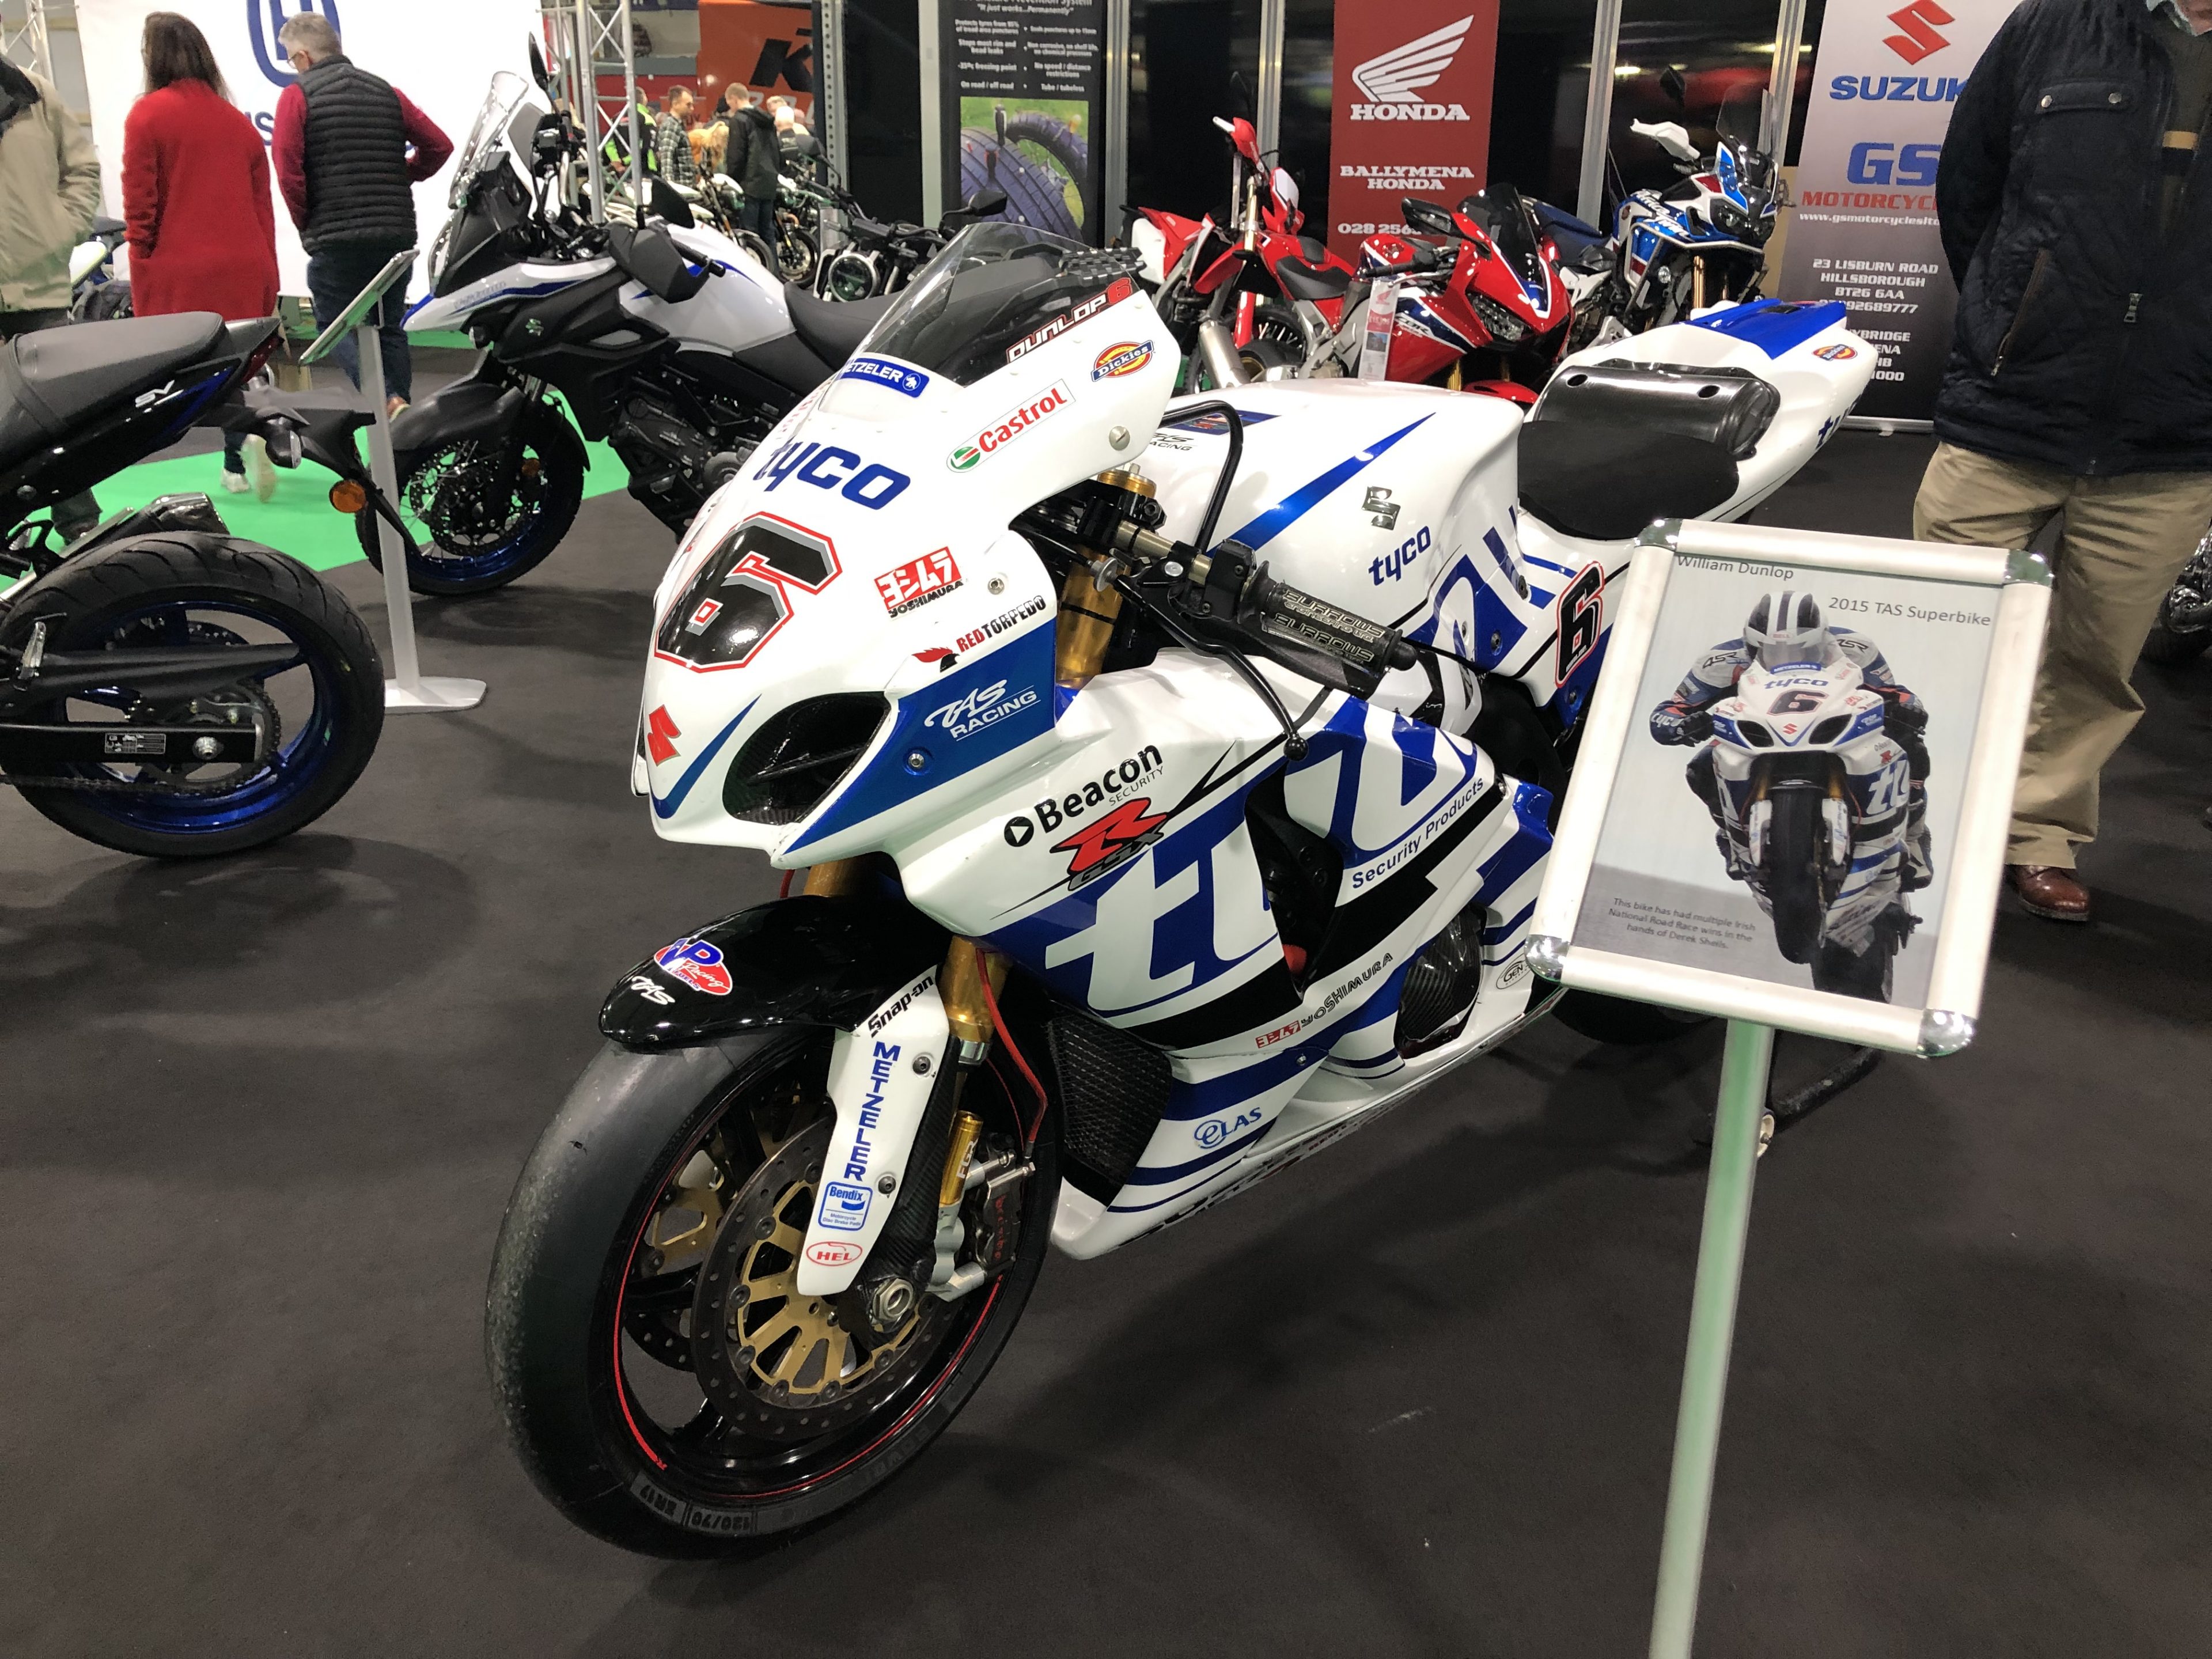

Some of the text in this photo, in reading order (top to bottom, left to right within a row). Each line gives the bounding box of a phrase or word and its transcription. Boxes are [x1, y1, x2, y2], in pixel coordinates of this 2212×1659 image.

[1829, 75, 1970, 102] SUZUK
[1350, 104, 1471, 120] HONDA
[1340, 165, 1475, 177] BALLYMENA
[1847, 142, 1942, 187] GS
[1368, 178, 1445, 190] HONDA
[1338, 223, 1375, 234] 028
[1813, 259, 1938, 274] 23 LISBURN ROAD
[1820, 272, 1926, 287] HILLSBOROUGH
[1835, 286, 1904, 300] BT26 6AA
[1097, 344, 1150, 377] Dickies
[979, 387, 1067, 453] Castrol
[1149, 441, 1193, 452] ACING
[752, 435, 911, 510] tyco
[1369, 525, 1431, 586] tyco
[1677, 555, 1794, 581] William Dunlop
[888, 578, 964, 619] YOSHIMURA
[1282, 589, 1386, 639] BURROWS
[1828, 597, 1991, 627] 2015 TAS Superbike
[1274, 612, 1374, 662] BURROWS
[1555, 560, 1605, 688] 6
[1764, 677, 1830, 690] tyco
[949, 691, 1037, 738] RACING
[1034, 744, 1163, 834] Beacon
[1108, 766, 1164, 806] SECURITY
[1352, 778, 1484, 889] Security Products
[1608, 908, 1753, 942] National Road Race wins in the
[1613, 897, 1631, 908] This
[1633, 902, 1653, 912] bike
[1654, 906, 1671, 916] has
[1673, 909, 1692, 919] had
[1692, 913, 1732, 927] multiple
[1626, 922, 1654, 935] hands
[1656, 929, 1668, 937] of
[1669, 930, 1696, 943] Derek
[658, 938, 724, 967] VP
[679, 959, 730, 988] Racing
[1301, 952, 1393, 1028] YOSHIMURA
[868, 976, 934, 1038] Snap-on
[843, 1040, 902, 1181] METZELER
[956, 1138, 979, 1179] FGR
[830, 1186, 863, 1201] Bendix
[816, 1251, 853, 1262] HEL
